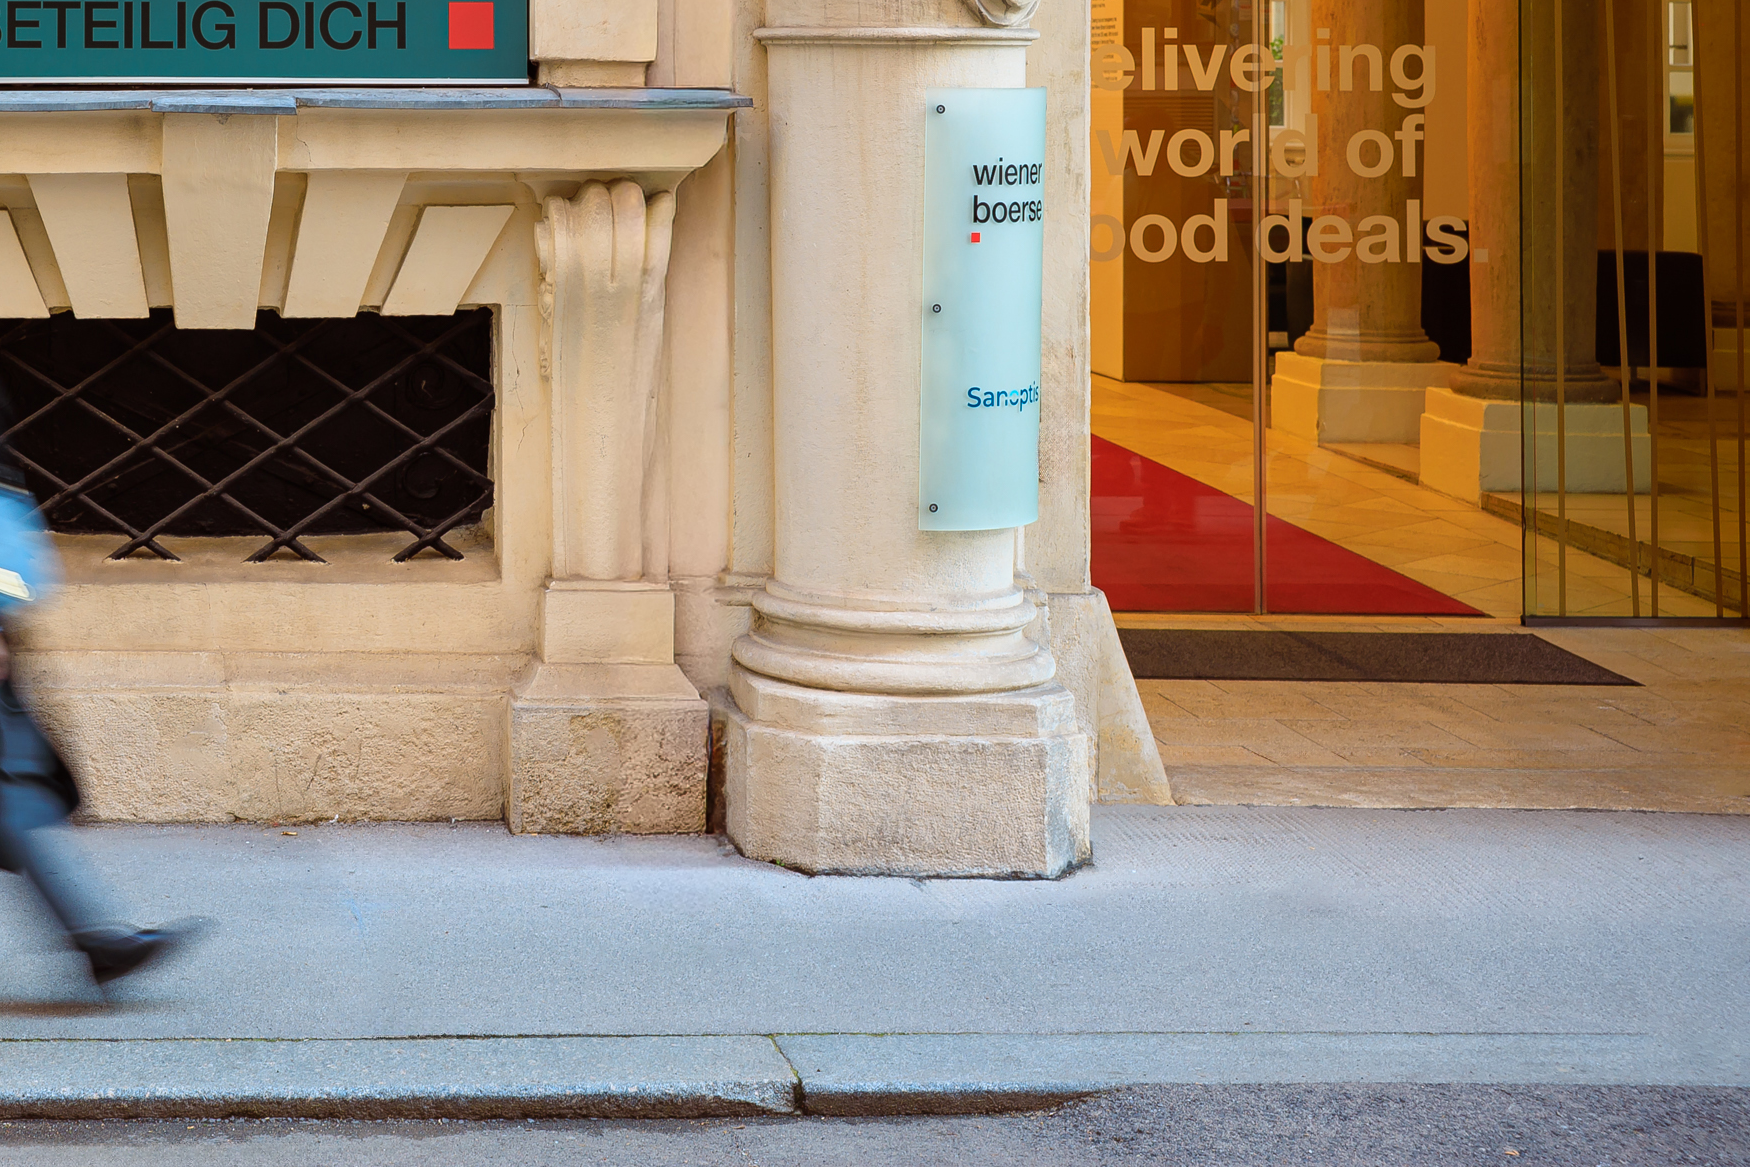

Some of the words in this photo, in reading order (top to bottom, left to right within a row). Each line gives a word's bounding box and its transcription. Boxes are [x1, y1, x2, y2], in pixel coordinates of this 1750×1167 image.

[259, 1, 406, 50] DICH
[1090, 27, 1436, 108] elivering
[1095, 113, 1318, 177] world
[1346, 114, 1424, 178] of
[973, 158, 1042, 185] wiener
[973, 195, 1042, 223] boerse
[1090, 198, 1228, 263] ood
[1255, 199, 1488, 264] deals.
[968, 381, 1038, 411] Sanoptis
